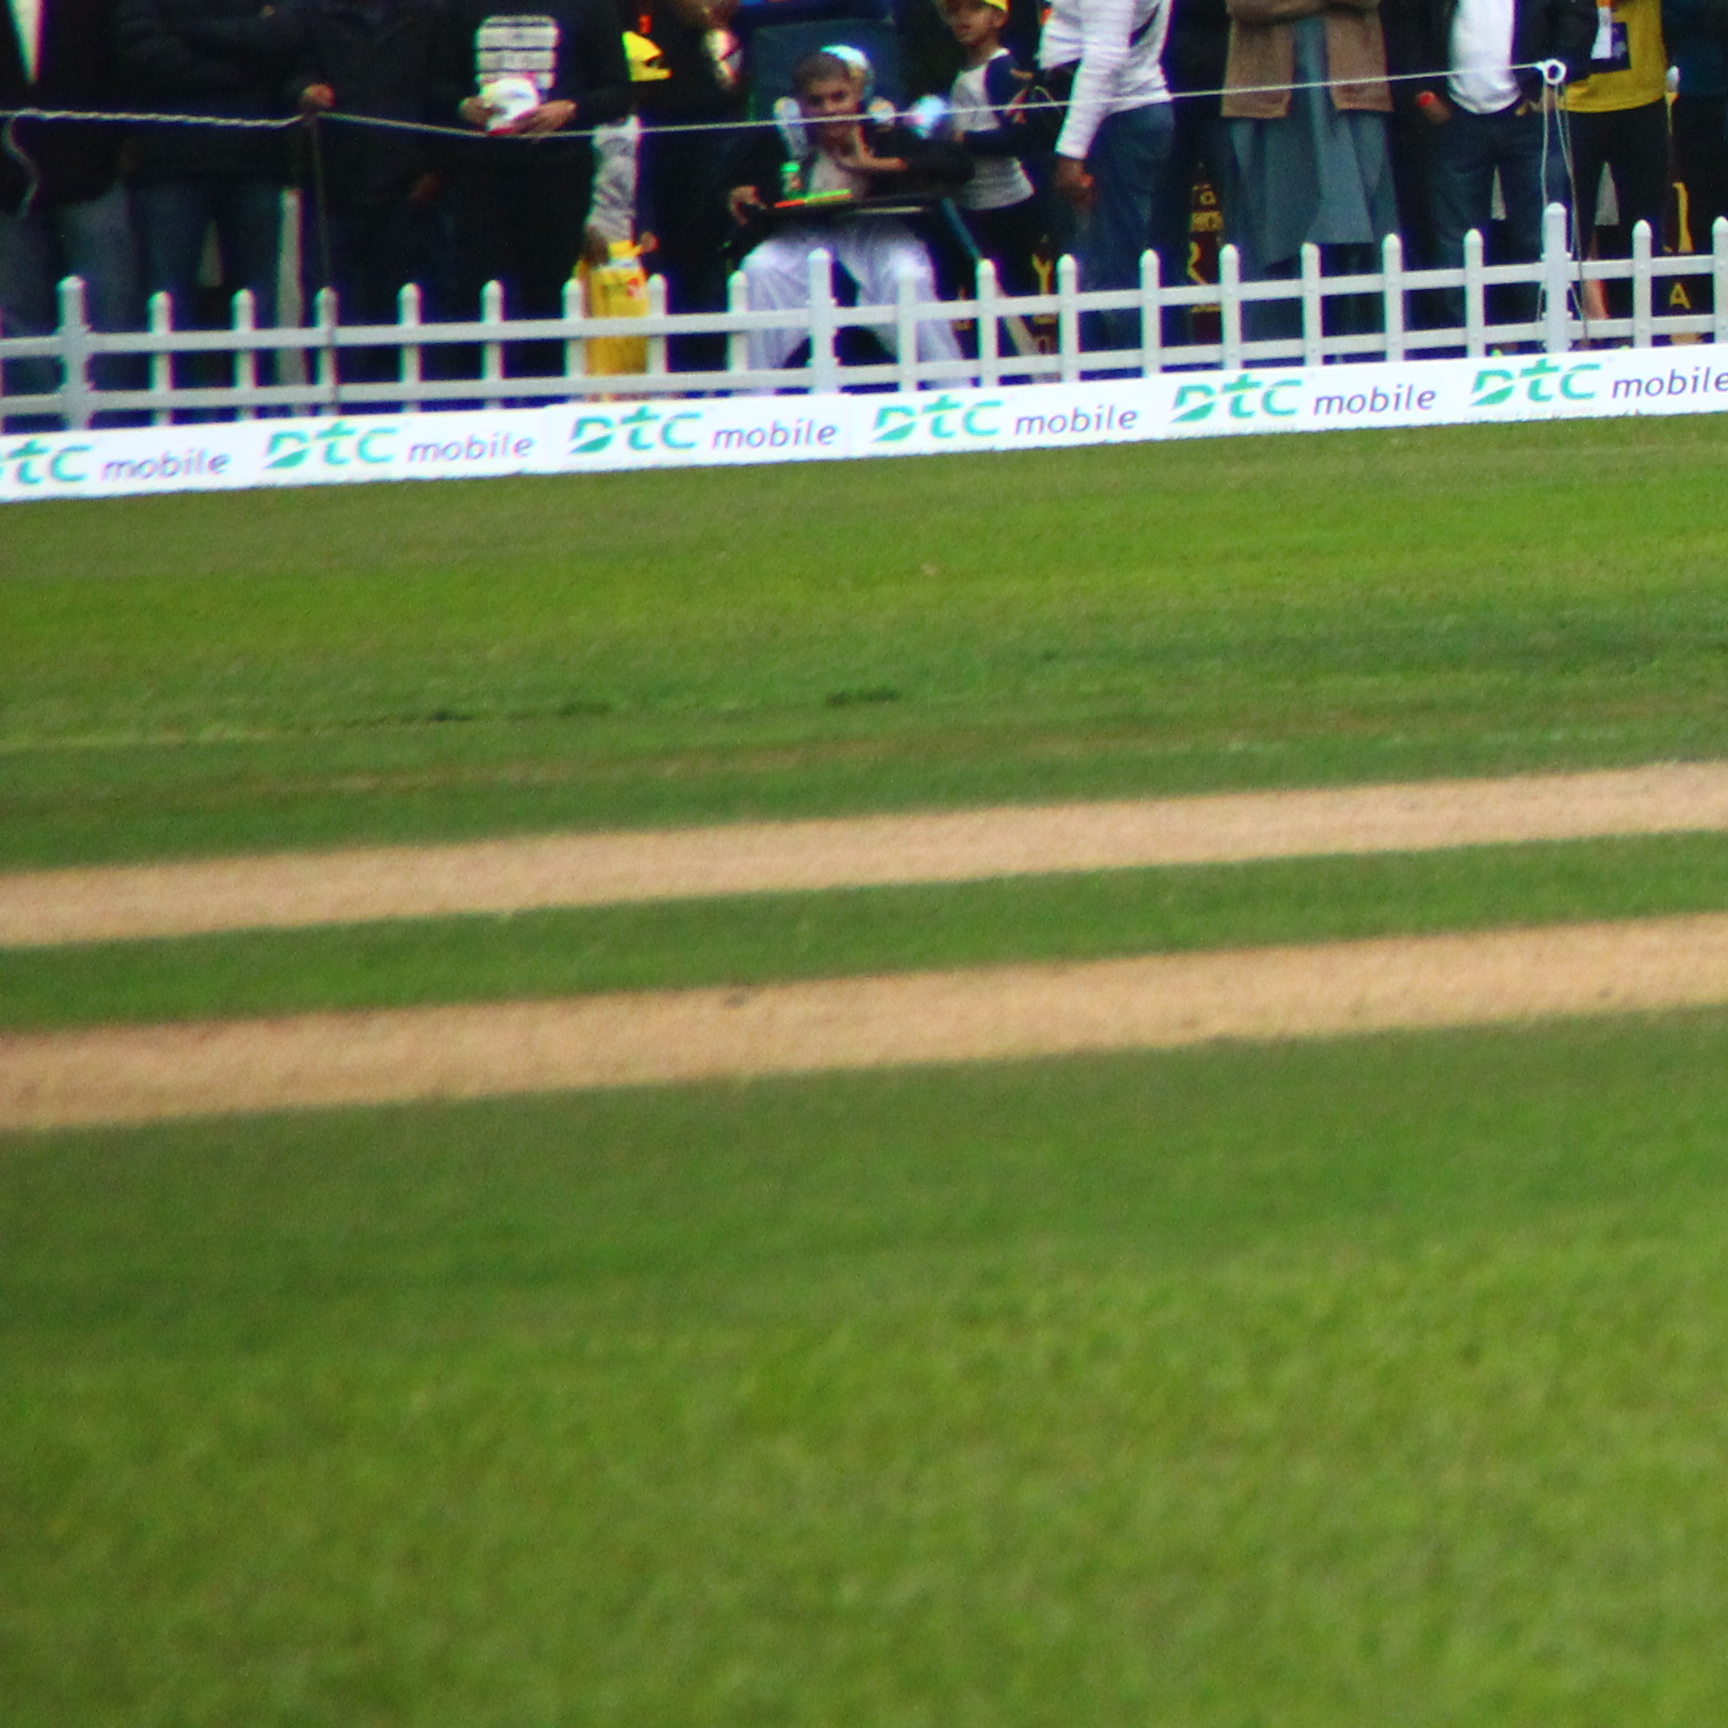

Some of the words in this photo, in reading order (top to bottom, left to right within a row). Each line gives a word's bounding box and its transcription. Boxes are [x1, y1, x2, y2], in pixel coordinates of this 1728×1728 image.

[1310, 382, 1438, 417] mobile
[710, 417, 839, 451] mobile
[1013, 403, 1140, 437] mobile
[100, 447, 231, 482] mobile
[406, 431, 537, 464] mobile
